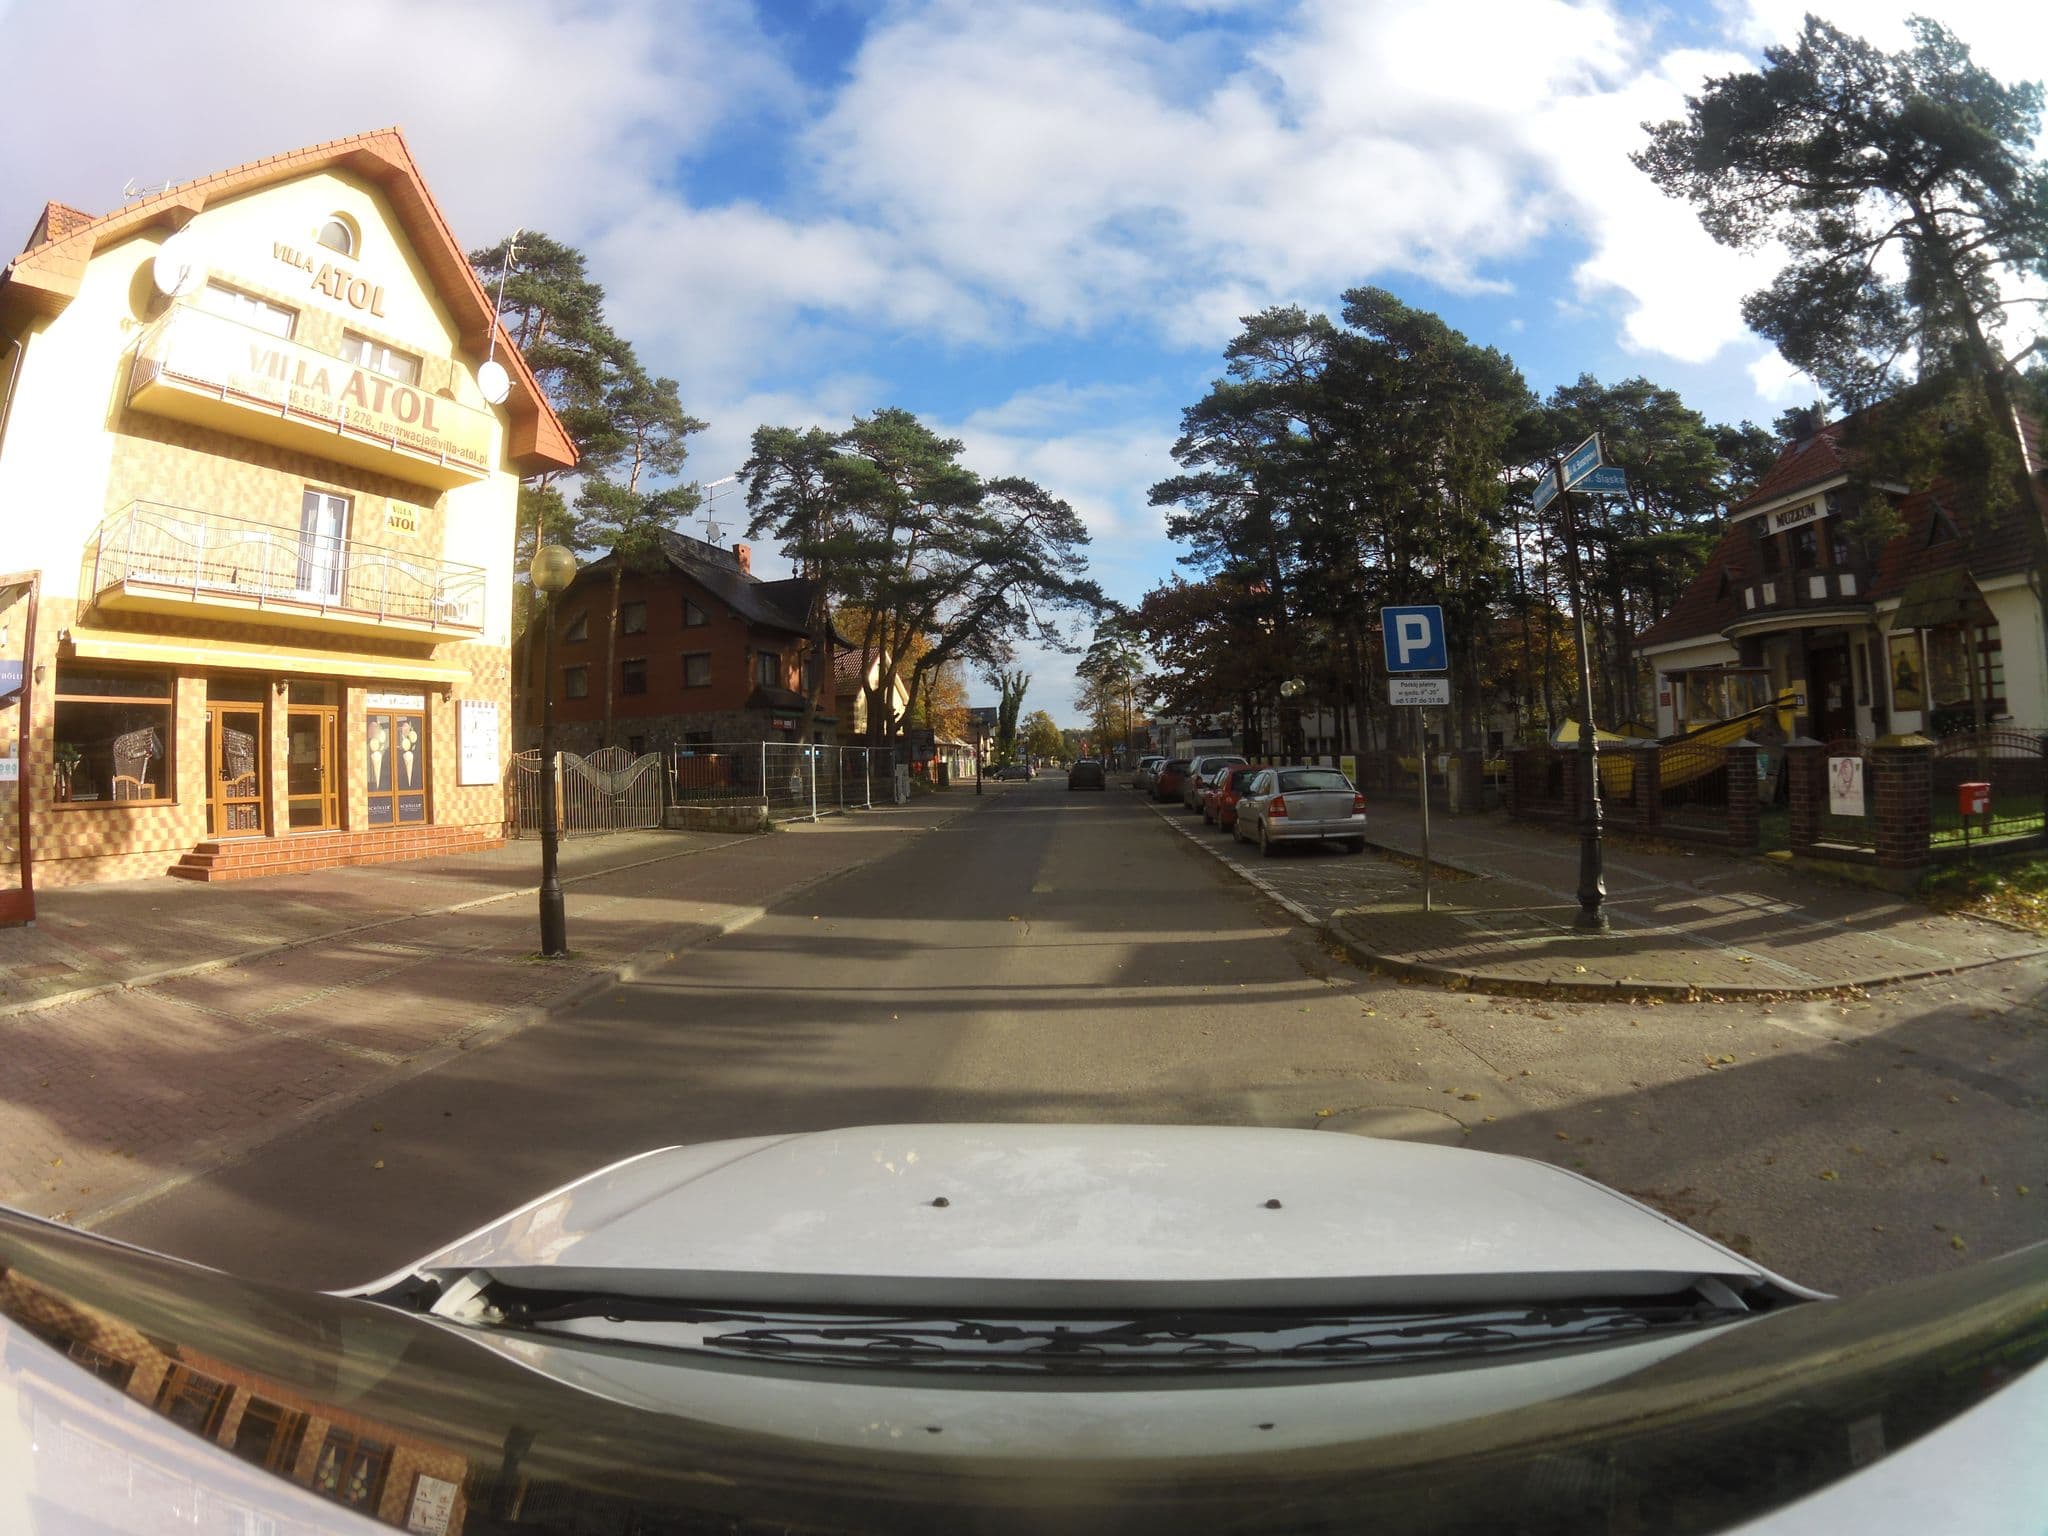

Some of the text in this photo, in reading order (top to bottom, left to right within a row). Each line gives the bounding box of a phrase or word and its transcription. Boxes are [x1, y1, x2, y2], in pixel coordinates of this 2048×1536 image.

[273, 241, 384, 318] VILLA ATOL
[249, 343, 332, 396] VILLA
[340, 369, 440, 433] ATOL
[387, 515, 416, 532] ATOL
[1775, 502, 1817, 528] MUZEUM
[1396, 614, 1431, 664] P
